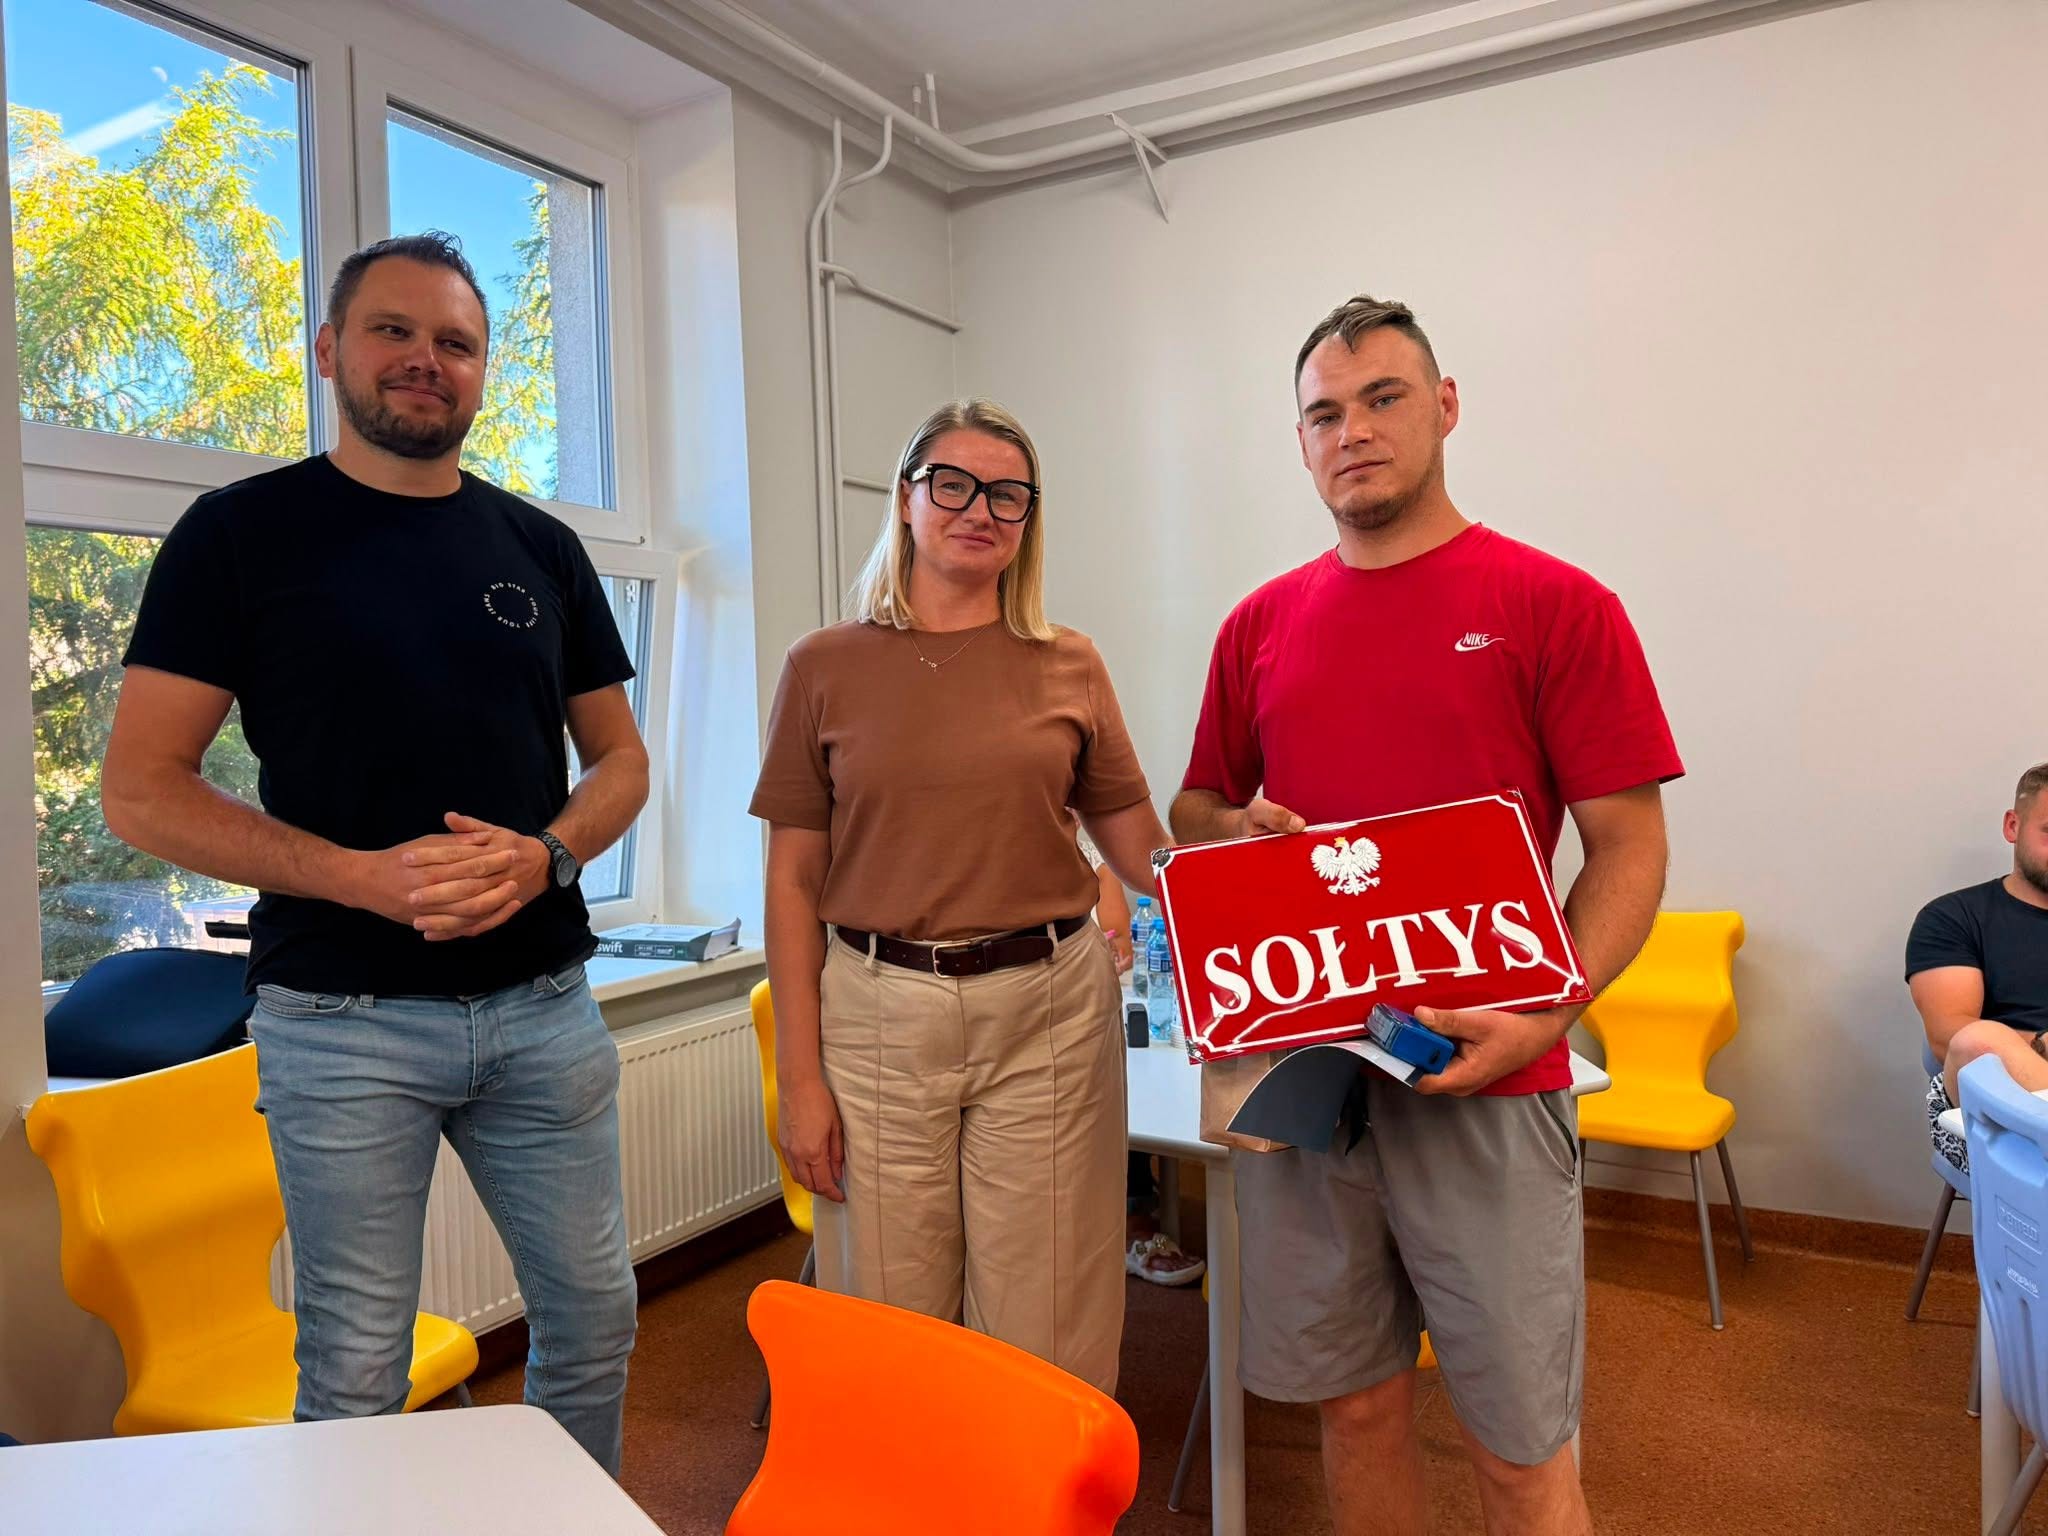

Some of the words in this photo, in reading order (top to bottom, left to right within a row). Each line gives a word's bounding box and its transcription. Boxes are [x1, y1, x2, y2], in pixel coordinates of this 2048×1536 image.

[490, 582, 504, 590] BIG
[507, 582, 526, 593] STAR
[483, 593, 496, 615] JEANS
[497, 616, 520, 628] YOUR
[1462, 631, 1490, 646] NIKE
[1203, 900, 1544, 1017] SOŁTYS
